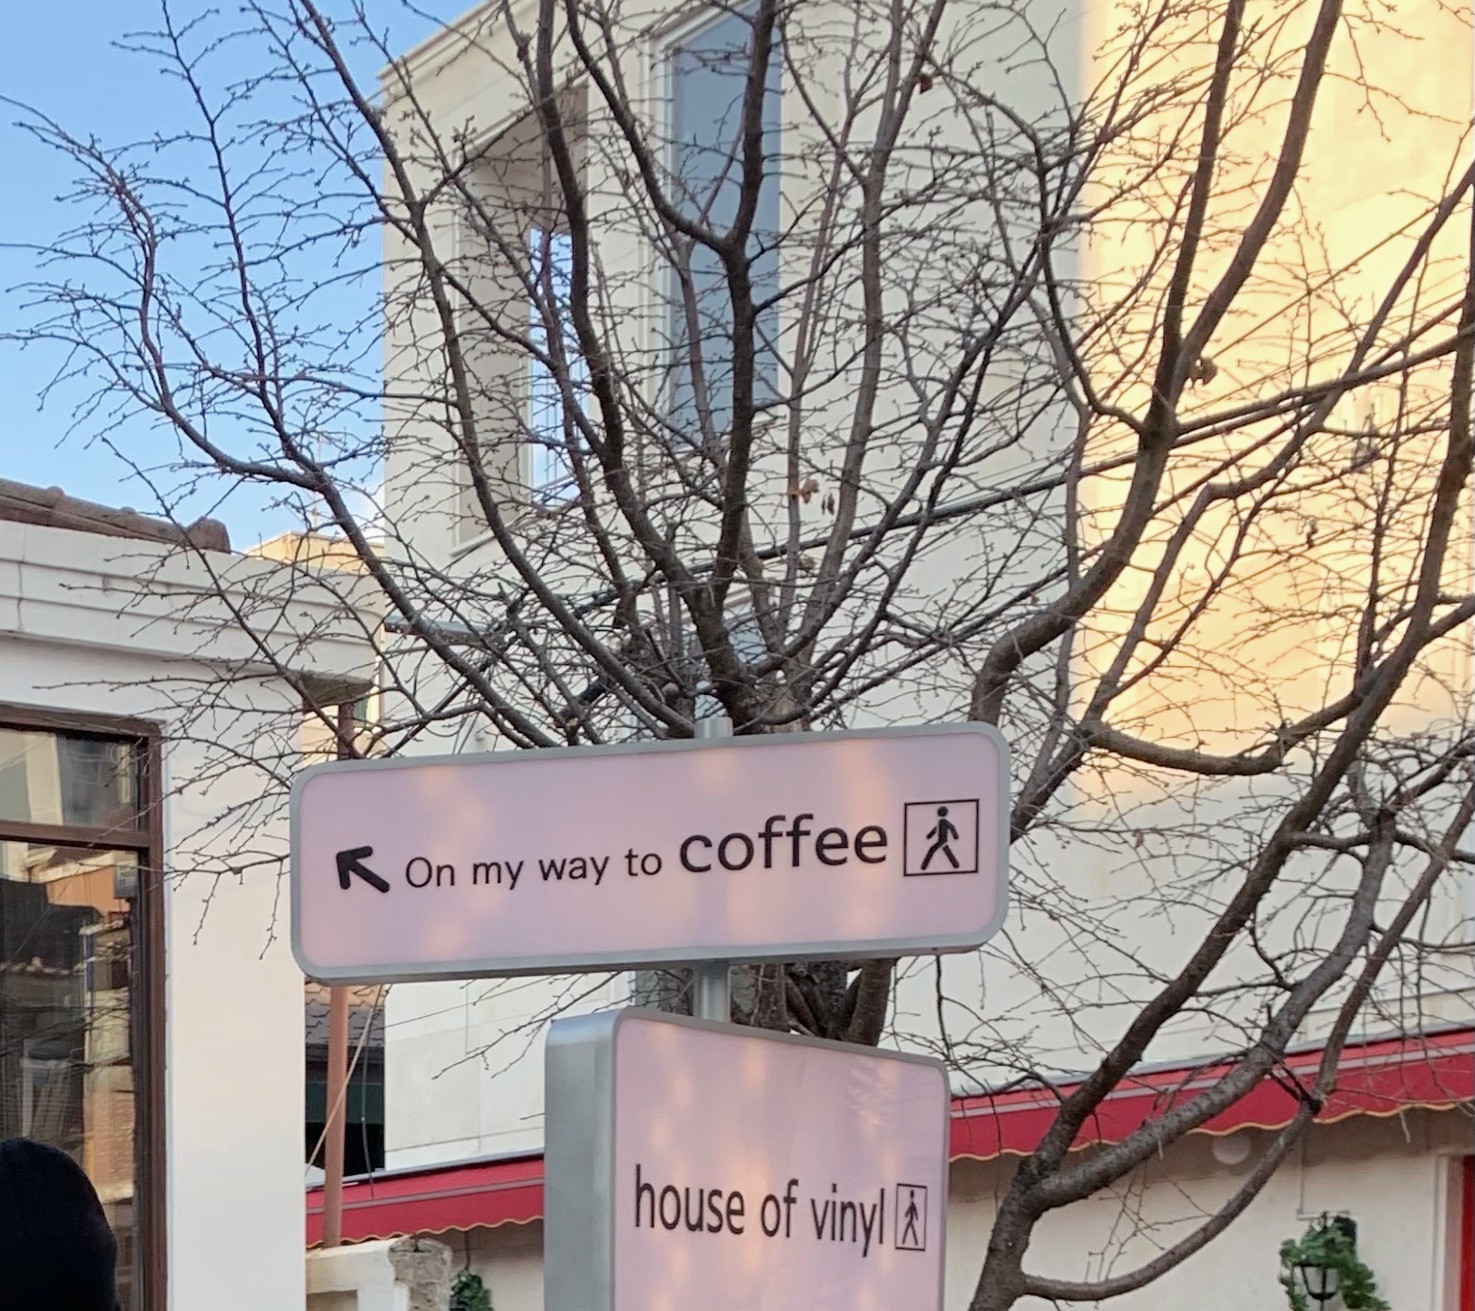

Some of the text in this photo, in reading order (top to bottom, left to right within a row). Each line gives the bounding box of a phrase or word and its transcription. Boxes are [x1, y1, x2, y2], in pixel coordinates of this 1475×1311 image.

[404, 812, 890, 892] On my way to coffee
[634, 1163, 887, 1259] house of vinyl
